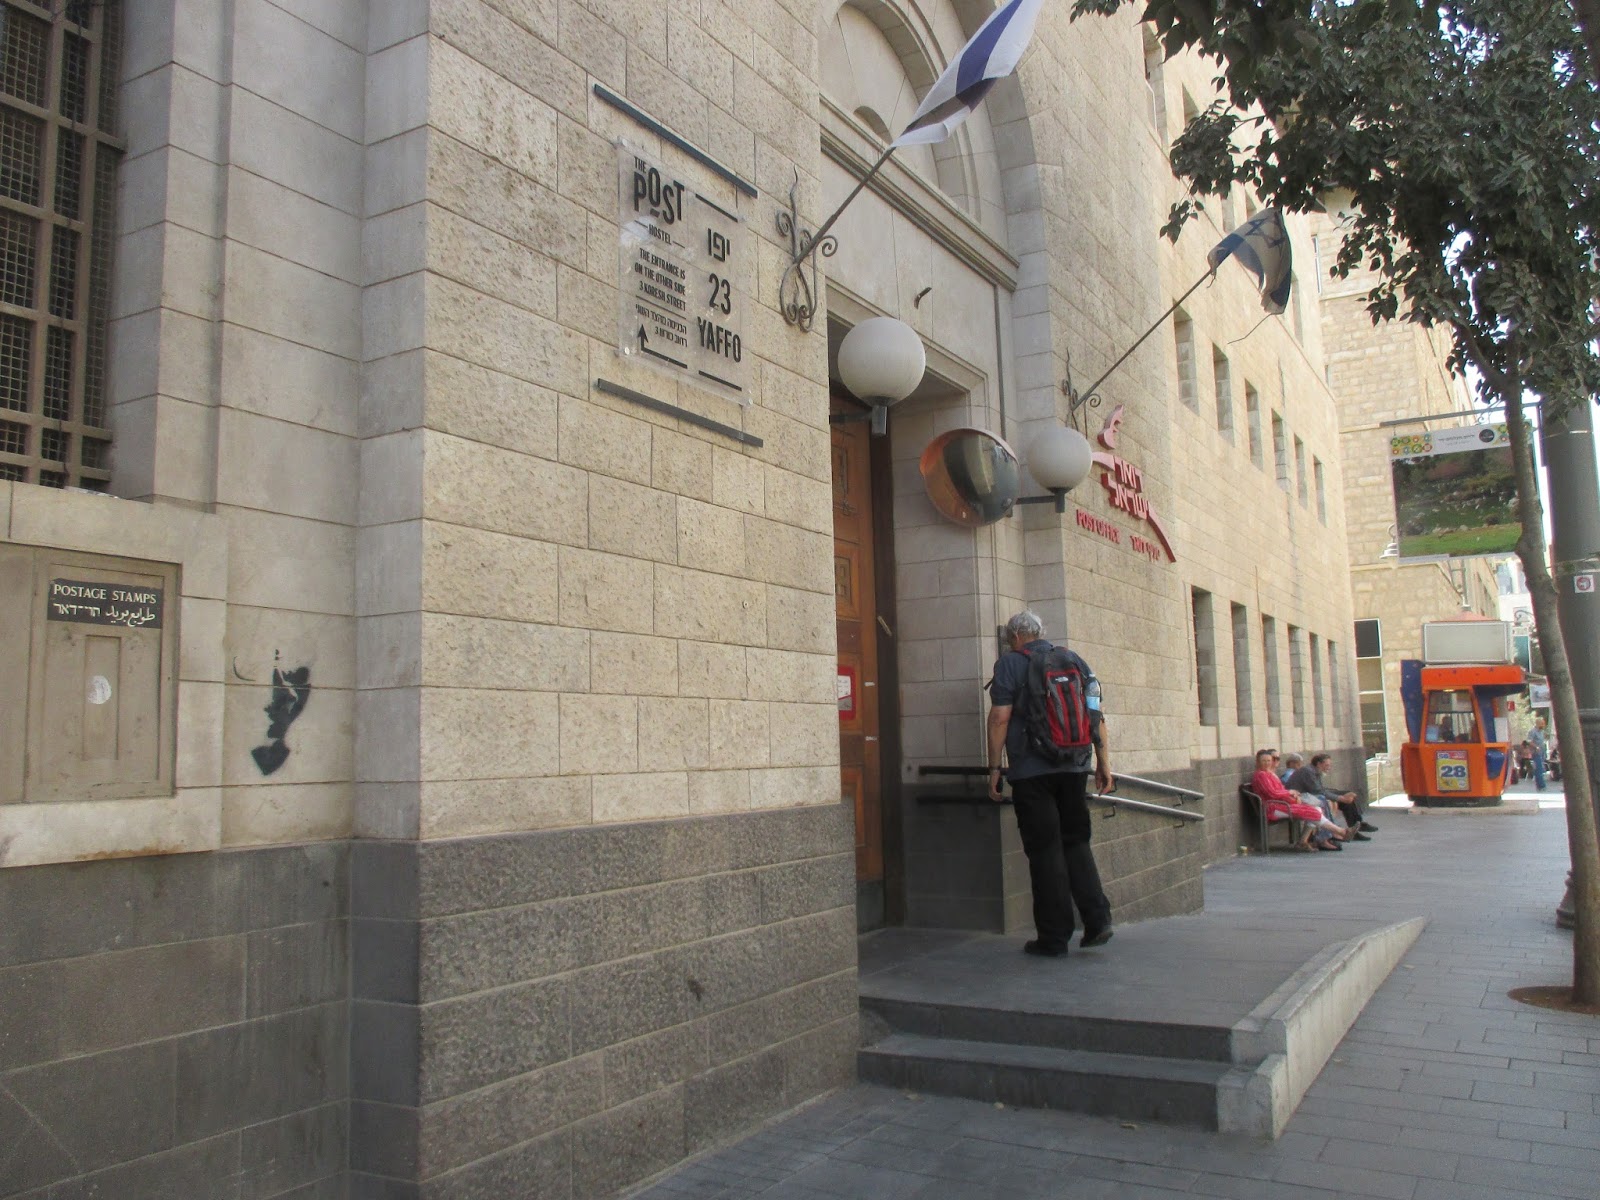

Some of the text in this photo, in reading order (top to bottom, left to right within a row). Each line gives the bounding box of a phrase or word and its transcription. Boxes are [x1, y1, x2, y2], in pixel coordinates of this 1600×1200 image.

[634, 156, 646, 173] THE
[634, 167, 684, 224] POST
[649, 224, 671, 245] HOSTEL
[708, 228, 730, 262] יפו
[635, 262, 686, 296] ON THE OTHER SIDE
[640, 247, 686, 280] THE ENTRANCE IS
[639, 280, 686, 311] 3 KORESH STREET
[709, 273, 731, 315] 23
[654, 325, 659, 335] 3
[697, 316, 741, 362] YAFFO
[53, 584, 157, 604] POSTAGE STAMPS
[1440, 765, 1466, 778] 28
